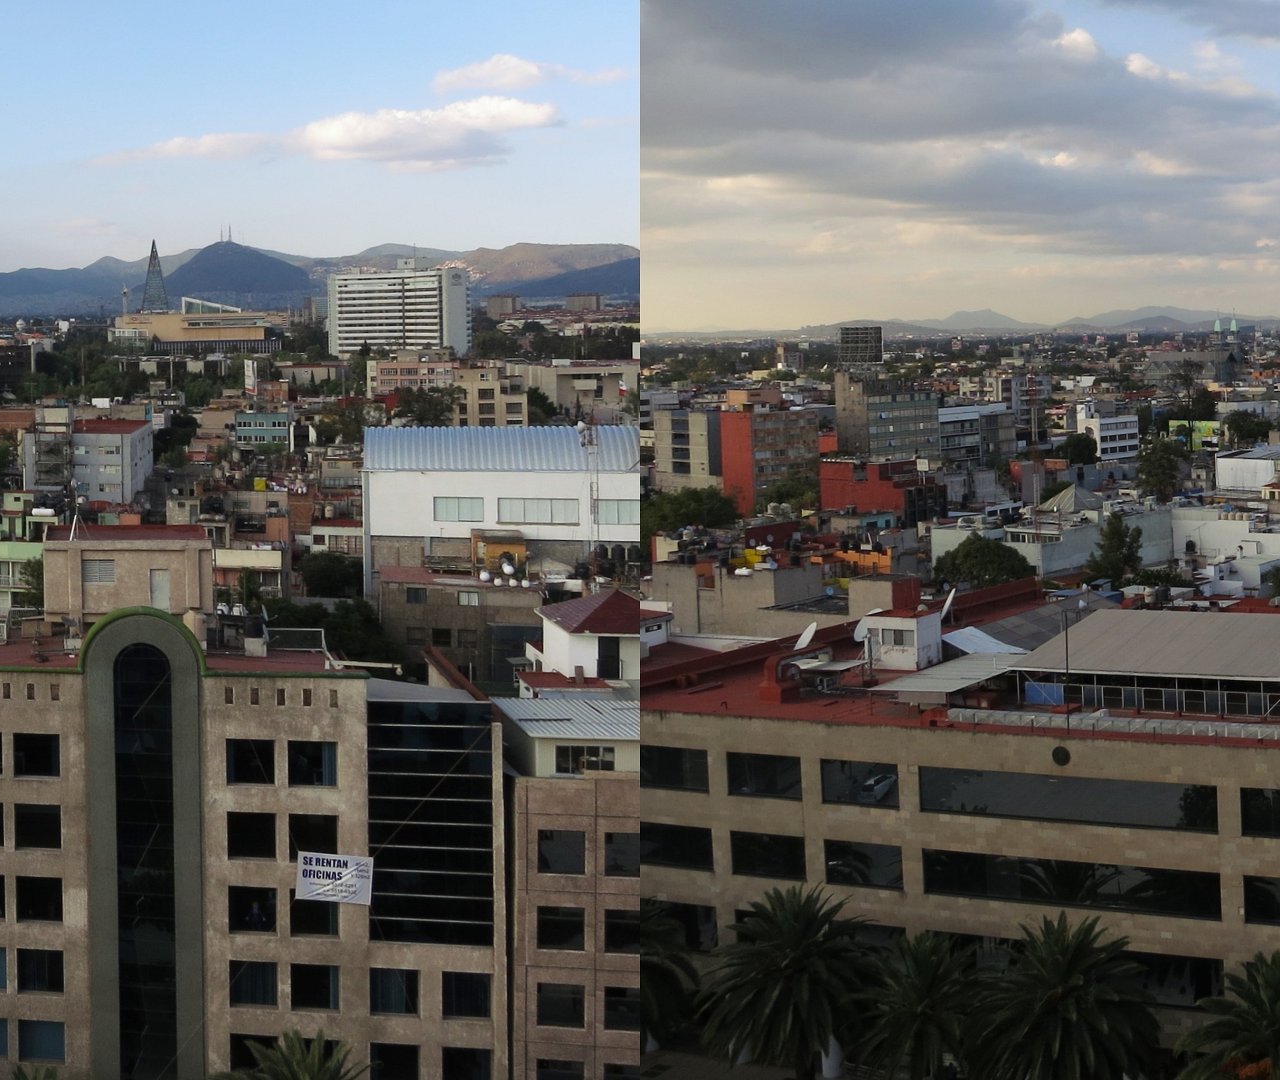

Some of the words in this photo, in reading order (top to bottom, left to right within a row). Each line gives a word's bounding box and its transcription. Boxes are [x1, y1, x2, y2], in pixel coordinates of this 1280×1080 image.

[303, 856, 313, 866] SE
[315, 857, 348, 868] RENTAN
[302, 869, 342, 880] OFICINAS
